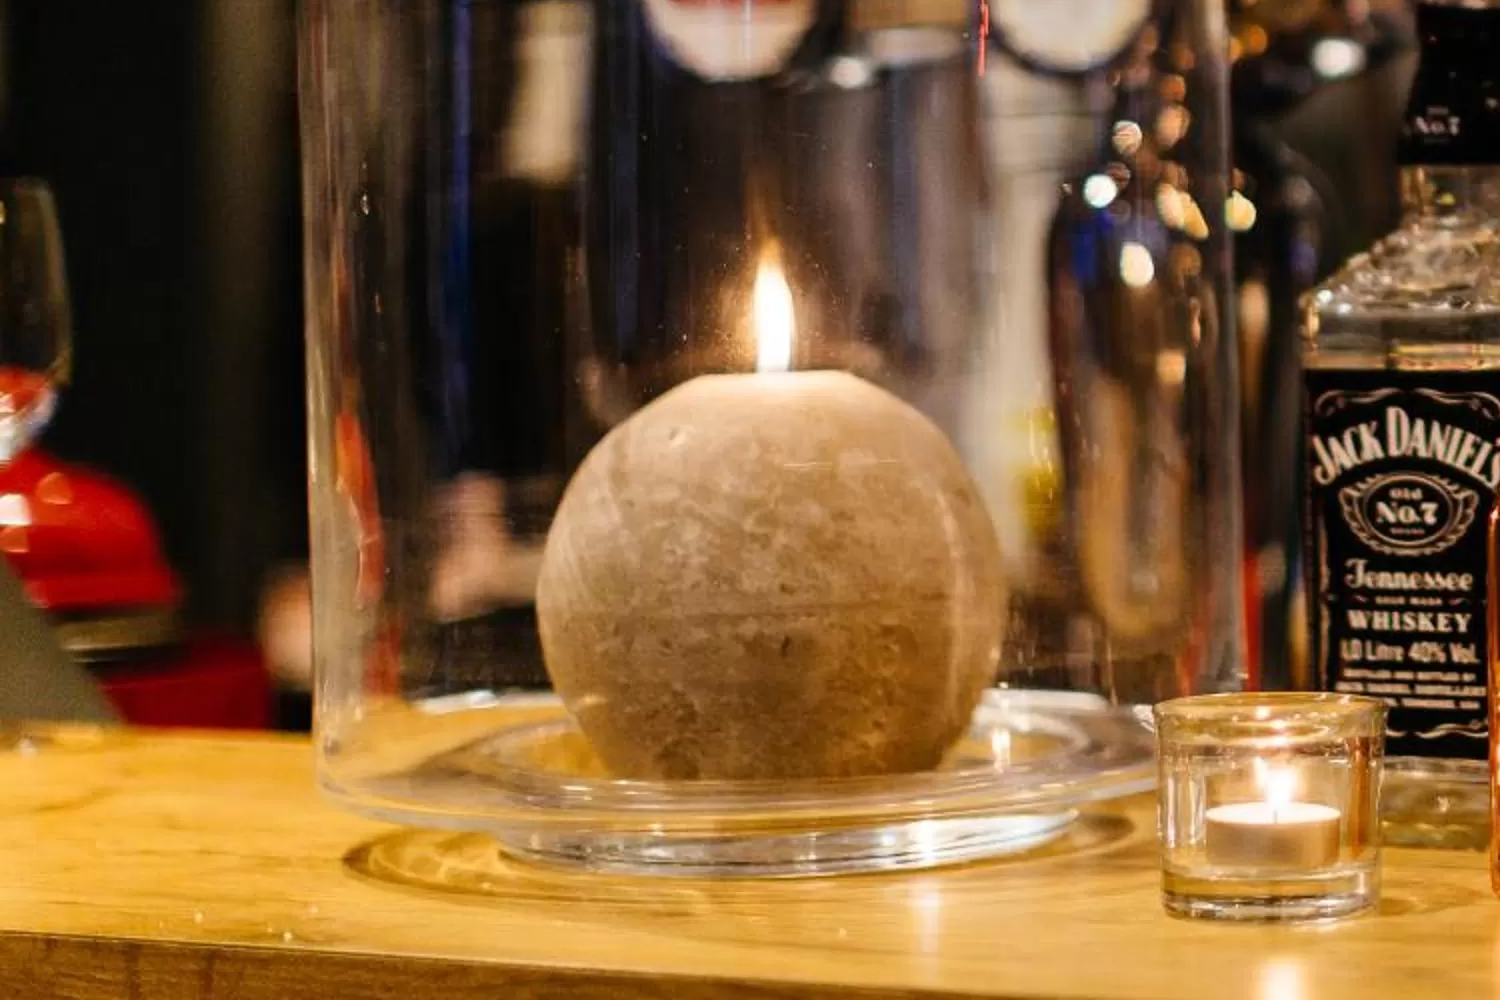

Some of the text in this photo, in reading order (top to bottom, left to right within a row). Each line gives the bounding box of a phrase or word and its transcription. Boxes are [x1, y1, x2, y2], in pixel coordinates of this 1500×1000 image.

[1312, 420, 1384, 486] JACK
[1344, 558, 1474, 592] Tennessee
[1346, 609, 1473, 633] WHISKEY
